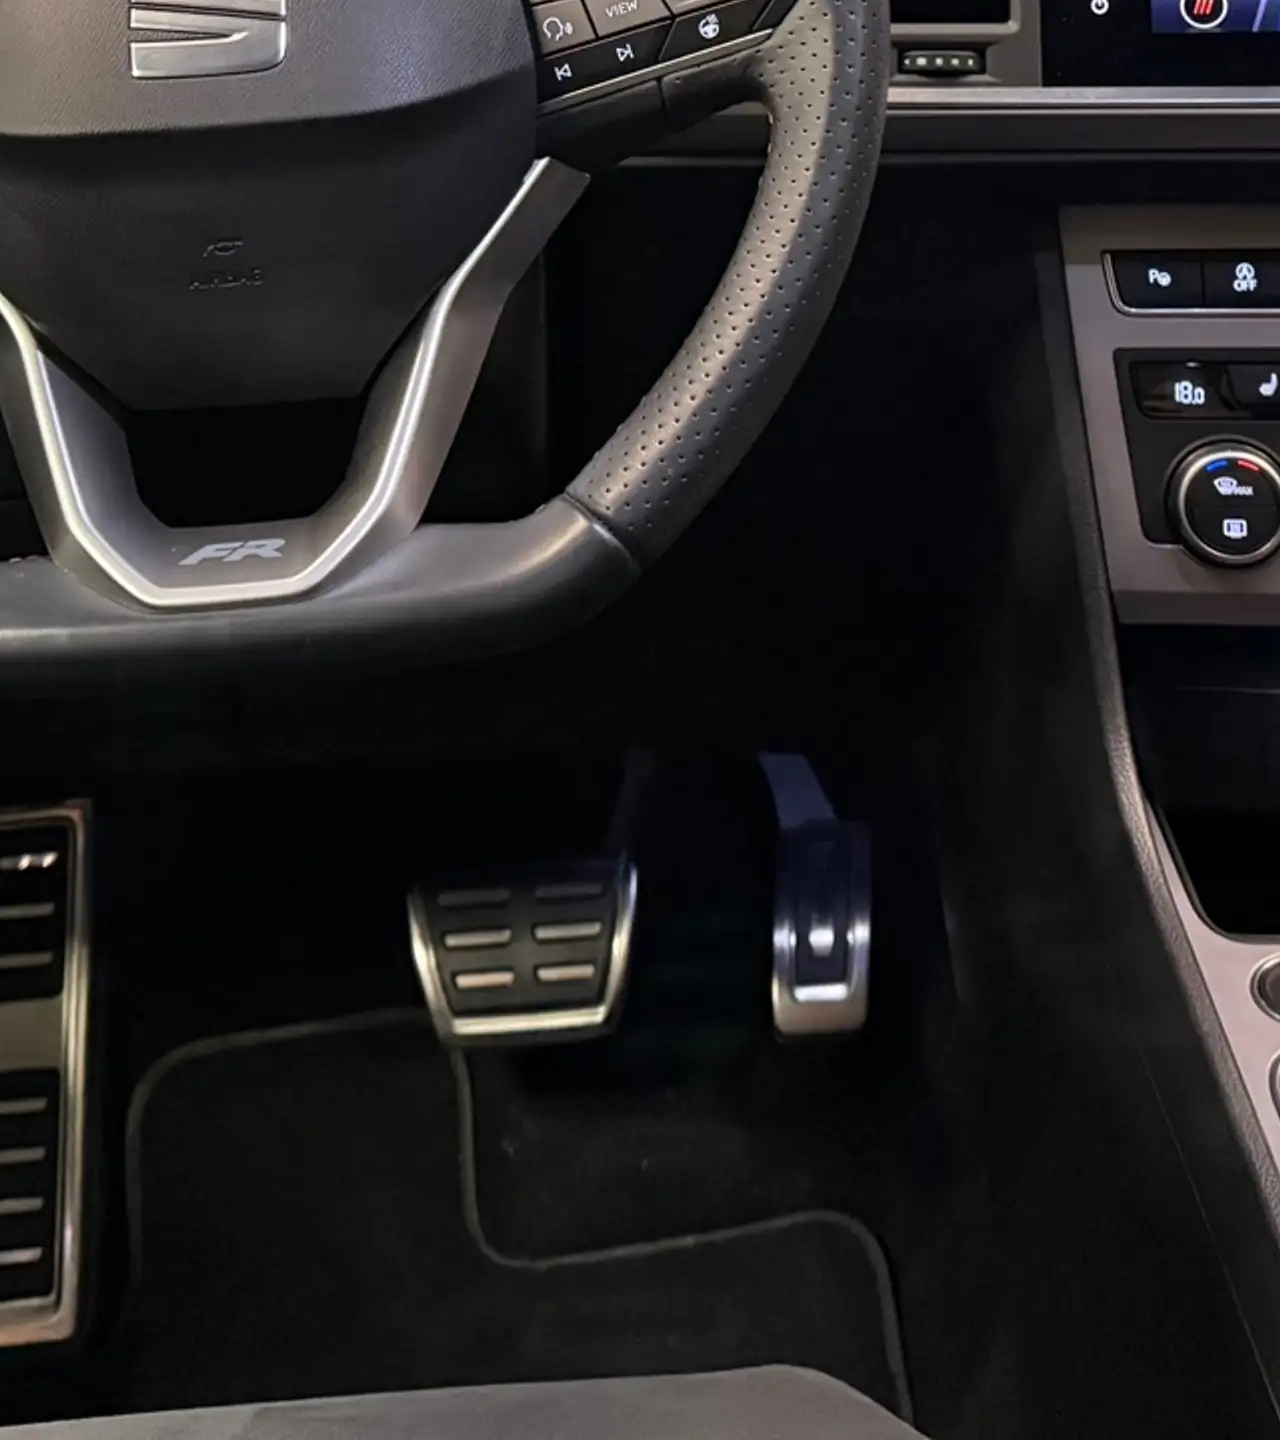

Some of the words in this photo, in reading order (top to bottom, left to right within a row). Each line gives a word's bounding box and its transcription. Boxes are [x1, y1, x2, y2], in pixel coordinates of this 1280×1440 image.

[1233, 279, 1258, 292] OFF
[1173, 380, 1206, 406] 18.0
[178, 537, 286, 566] FR
